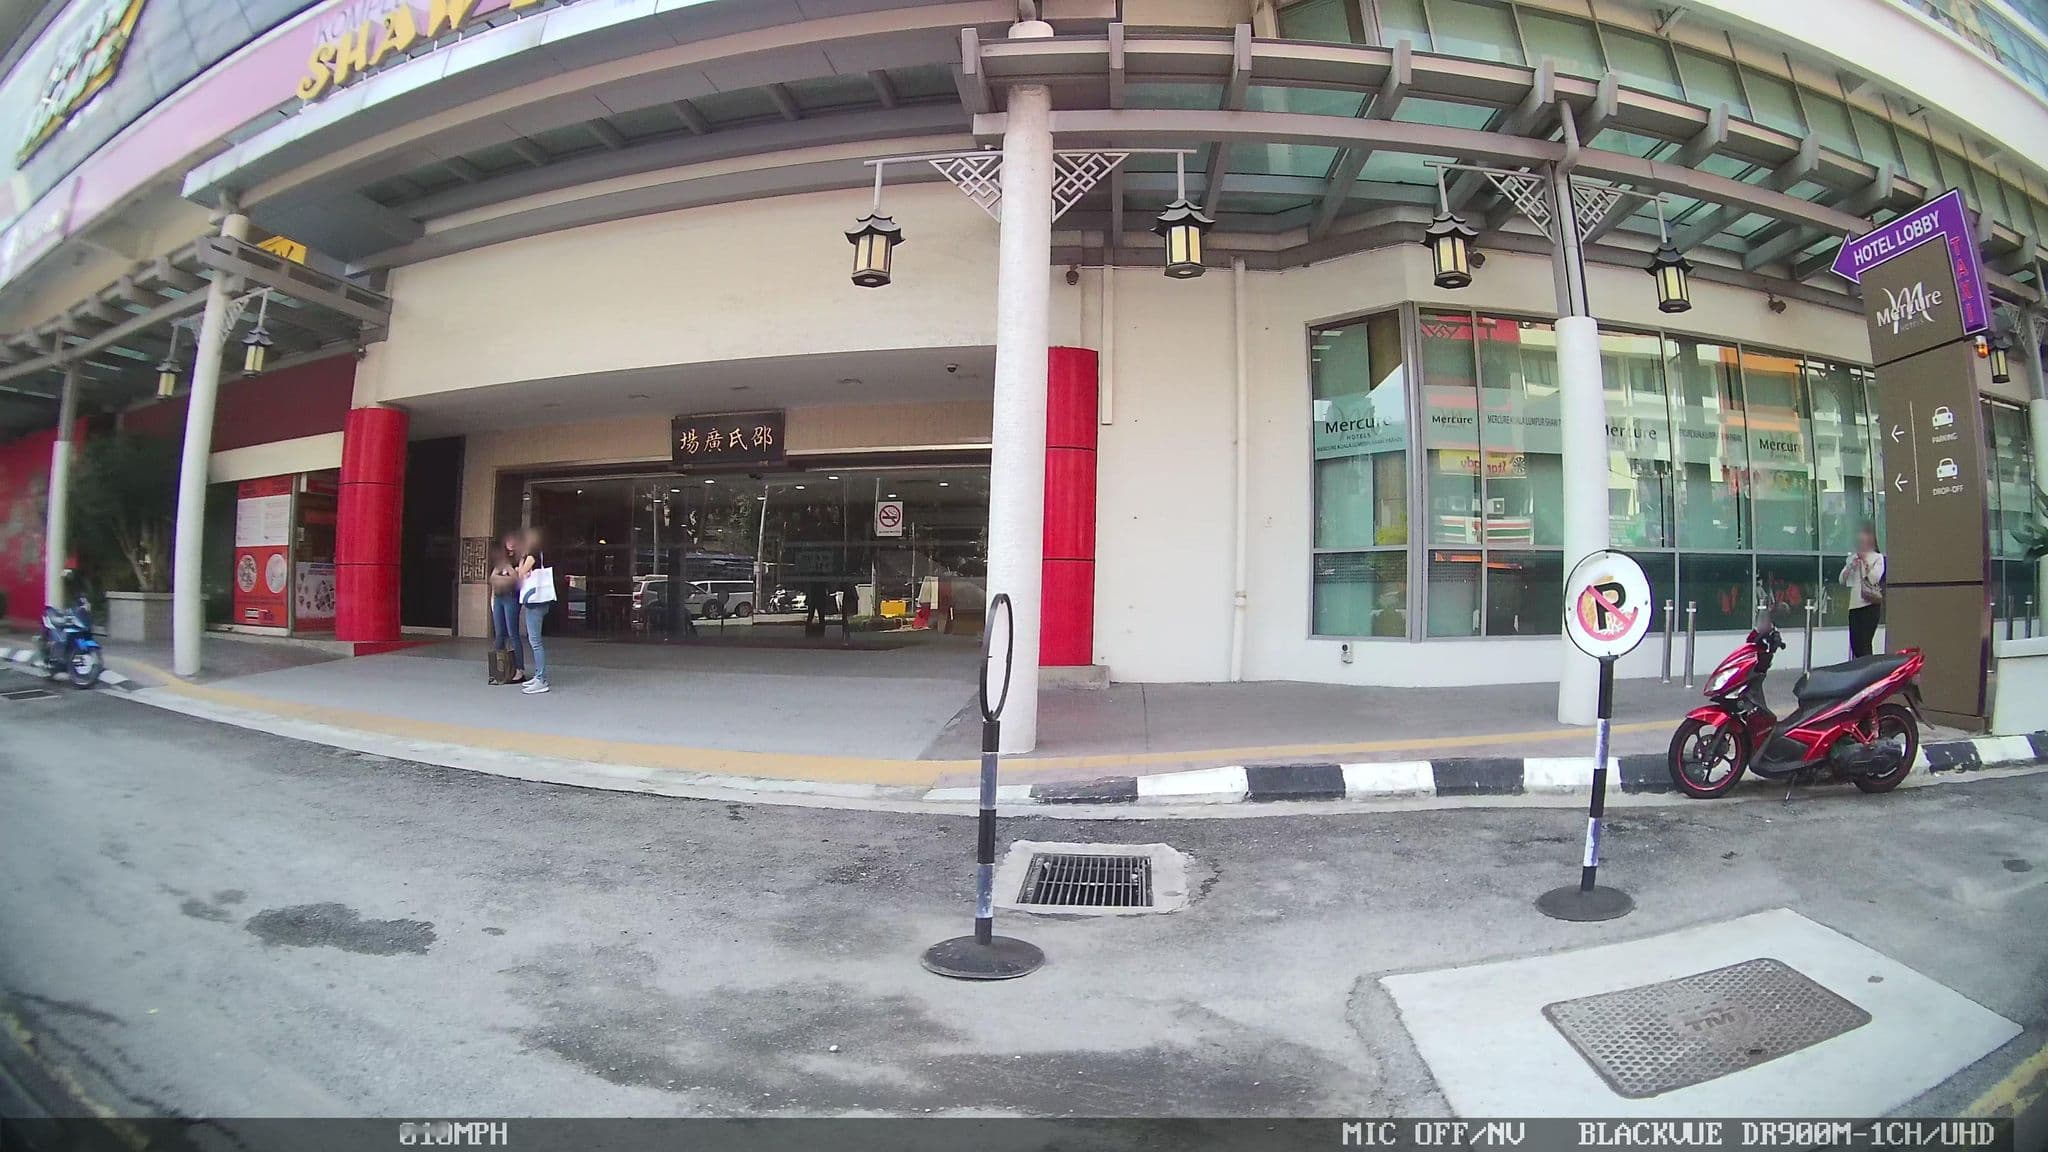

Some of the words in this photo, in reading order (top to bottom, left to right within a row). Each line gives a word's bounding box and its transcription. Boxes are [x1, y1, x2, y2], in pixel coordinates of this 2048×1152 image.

[296, 0, 477, 100] SHAW
[1853, 234, 1896, 267] HOTEL
[1895, 210, 1941, 247] LOBBY
[1876, 289, 1944, 328] Mercure
[1325, 413, 1393, 435] Mercure
[1432, 414, 1474, 425] Mercure
[1759, 437, 1802, 453] Mercur
[1932, 484, 1965, 496] DROP-OFF
